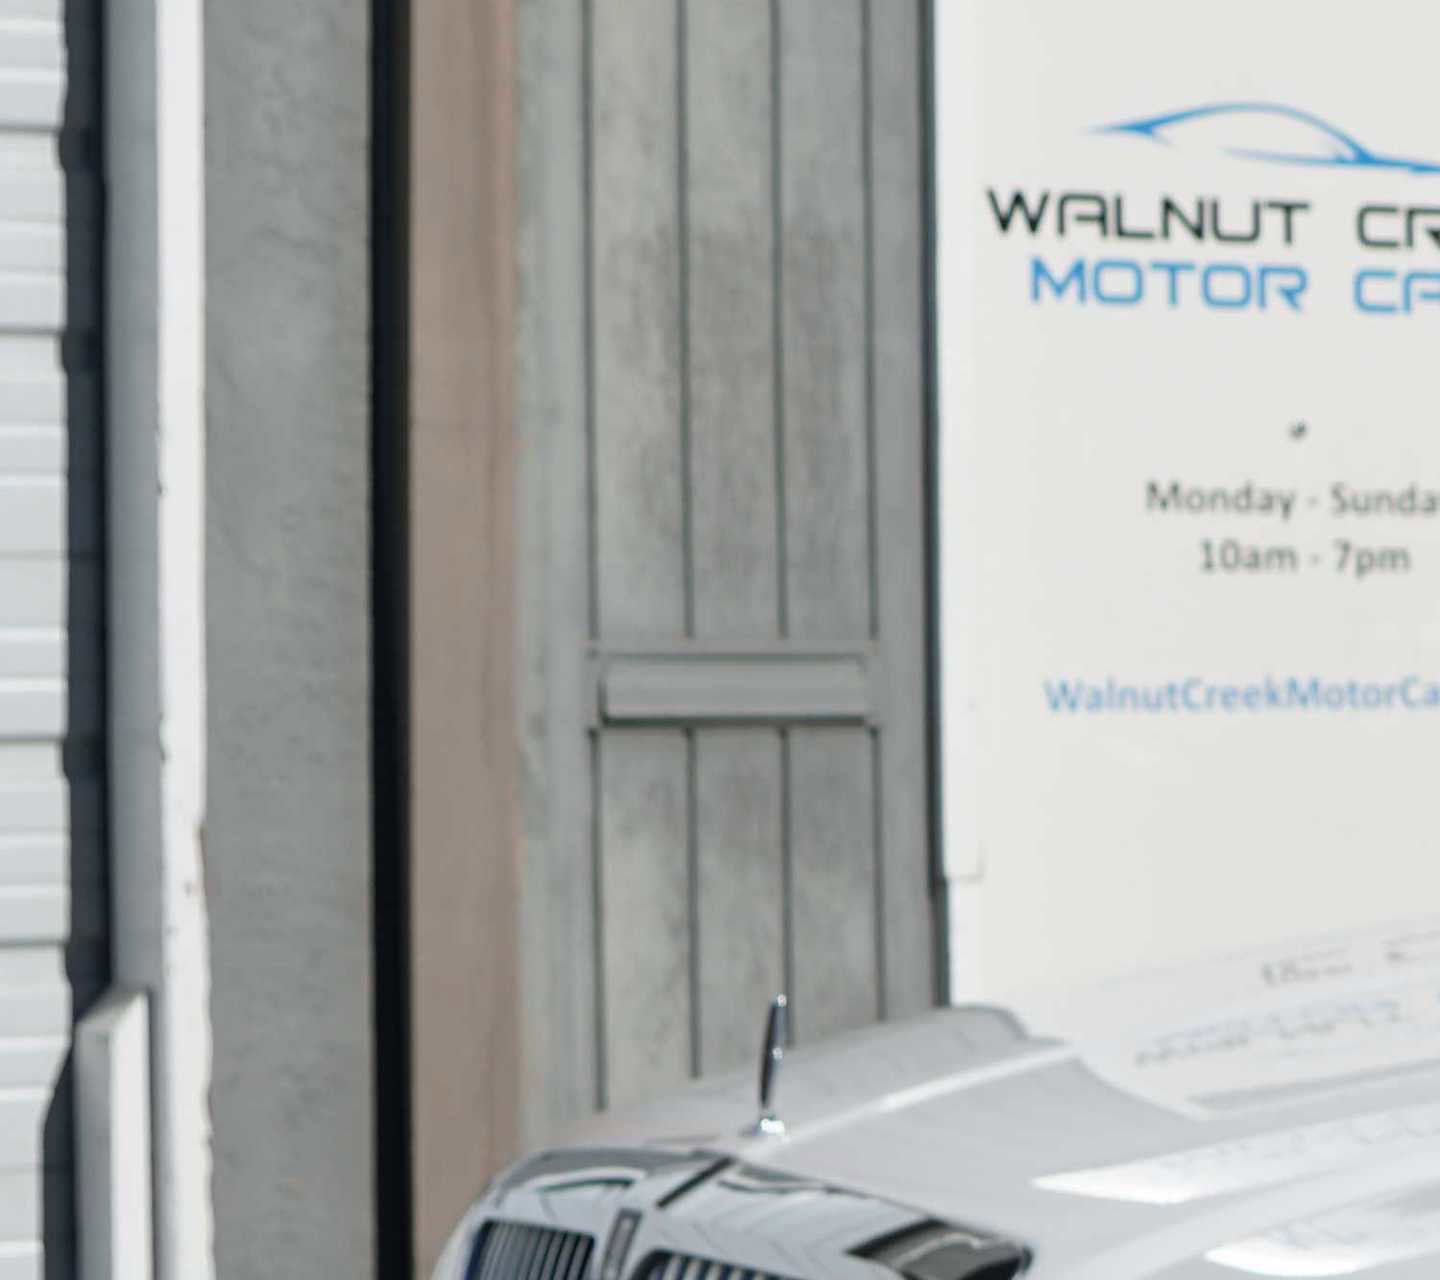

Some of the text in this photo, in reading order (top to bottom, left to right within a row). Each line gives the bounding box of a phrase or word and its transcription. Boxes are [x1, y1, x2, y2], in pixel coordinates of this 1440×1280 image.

[986, 185, 1310, 246] WALNUT
[1031, 255, 1309, 313] MOTOR
[1146, 480, 1296, 521] Monday
[1201, 539, 1298, 573] 10am
[1335, 539, 1413, 580] 7pm
